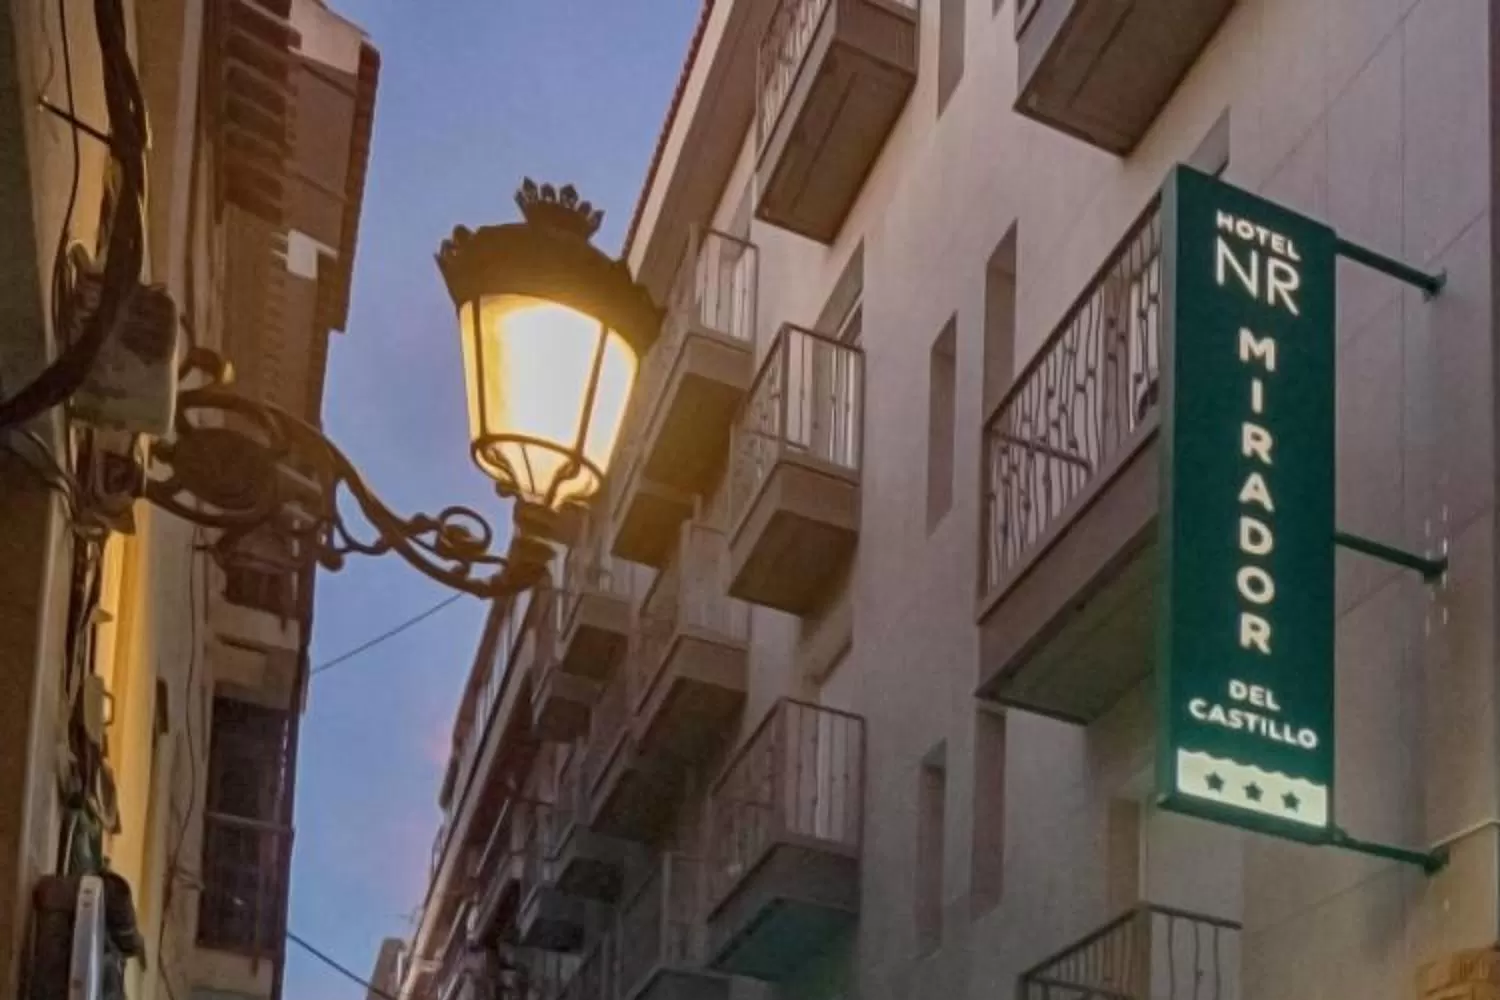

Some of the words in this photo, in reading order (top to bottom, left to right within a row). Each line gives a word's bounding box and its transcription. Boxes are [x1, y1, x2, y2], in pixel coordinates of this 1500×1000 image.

[1215, 209, 1302, 262] HOTEL
[1214, 234, 1301, 317] NR
[1236, 326, 1276, 655] MIRADOR
[1228, 678, 1281, 712] DEL
[1188, 698, 1319, 750] CASTILLO
